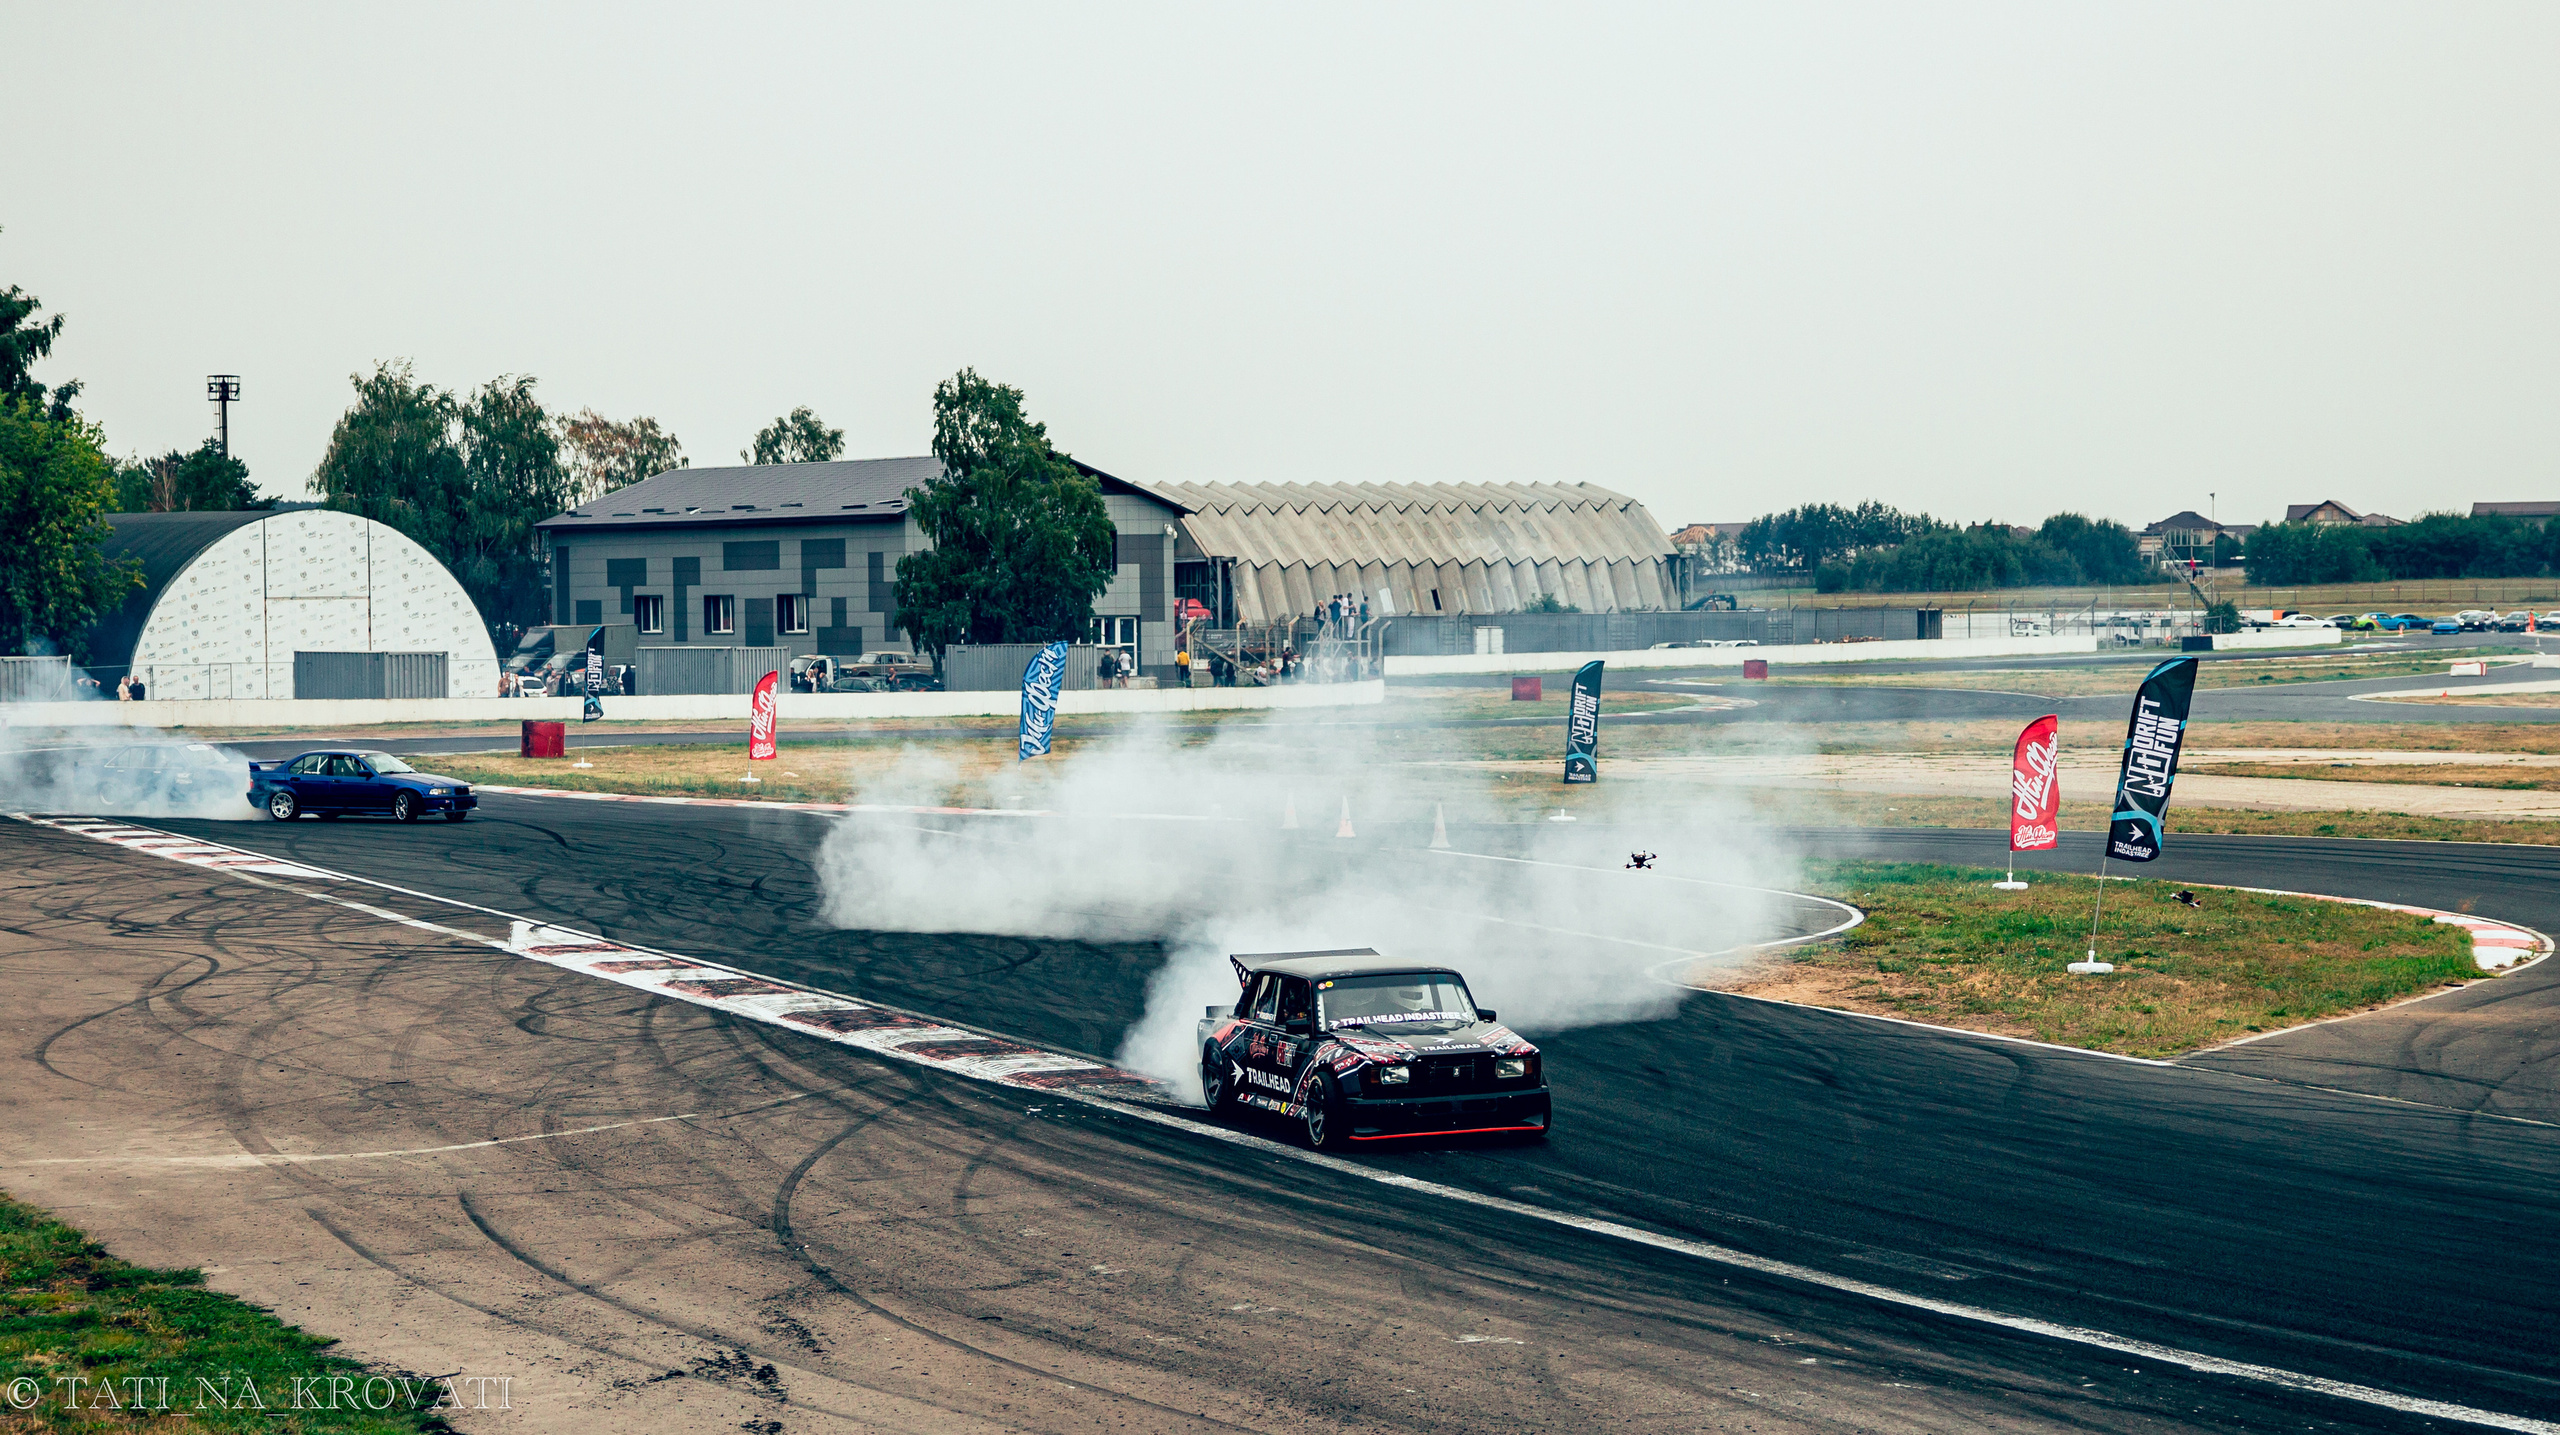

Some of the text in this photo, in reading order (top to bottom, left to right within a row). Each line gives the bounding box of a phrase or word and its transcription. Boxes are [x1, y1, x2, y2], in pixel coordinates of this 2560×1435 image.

[1573, 682, 1587, 715] DRIFT
[1585, 695, 1597, 718] FUN
[2132, 695, 2161, 749] DRIFT
[2154, 716, 2180, 754] FUN
[2114, 847, 2149, 858] INDASTREE
[2115, 841, 2152, 853] TRAILHEAD
[1341, 1011, 1461, 1026] TRAILHEAD INDASTREE
[1421, 1043, 1481, 1051] TRAILHEAD
[1247, 1067, 1291, 1093] TRAILHEAD
